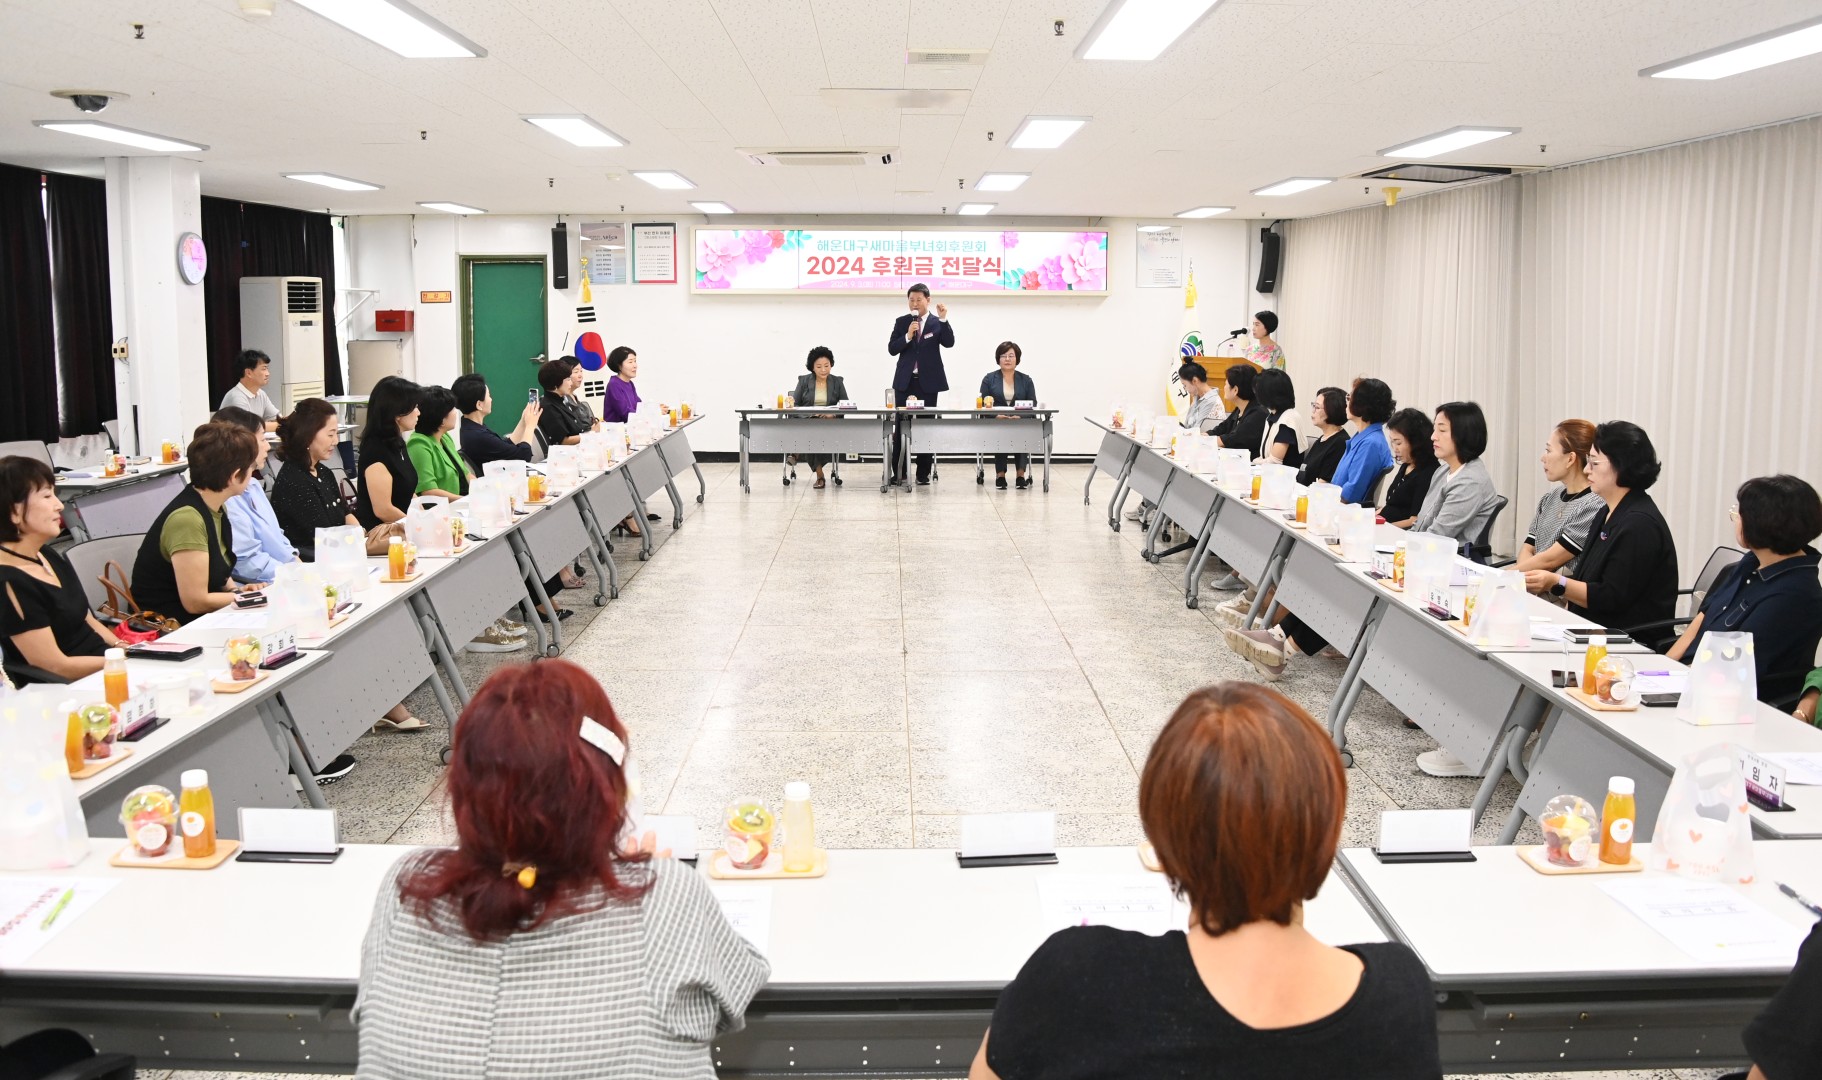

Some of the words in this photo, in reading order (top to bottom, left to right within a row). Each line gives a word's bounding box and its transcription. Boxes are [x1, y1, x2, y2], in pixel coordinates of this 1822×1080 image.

[817, 239, 987, 253] 해운대구새마을부녀회후원회
[807, 256, 865, 275] 2024
[872, 255, 934, 276] 후원금
[941, 255, 1001, 276] 전달식
